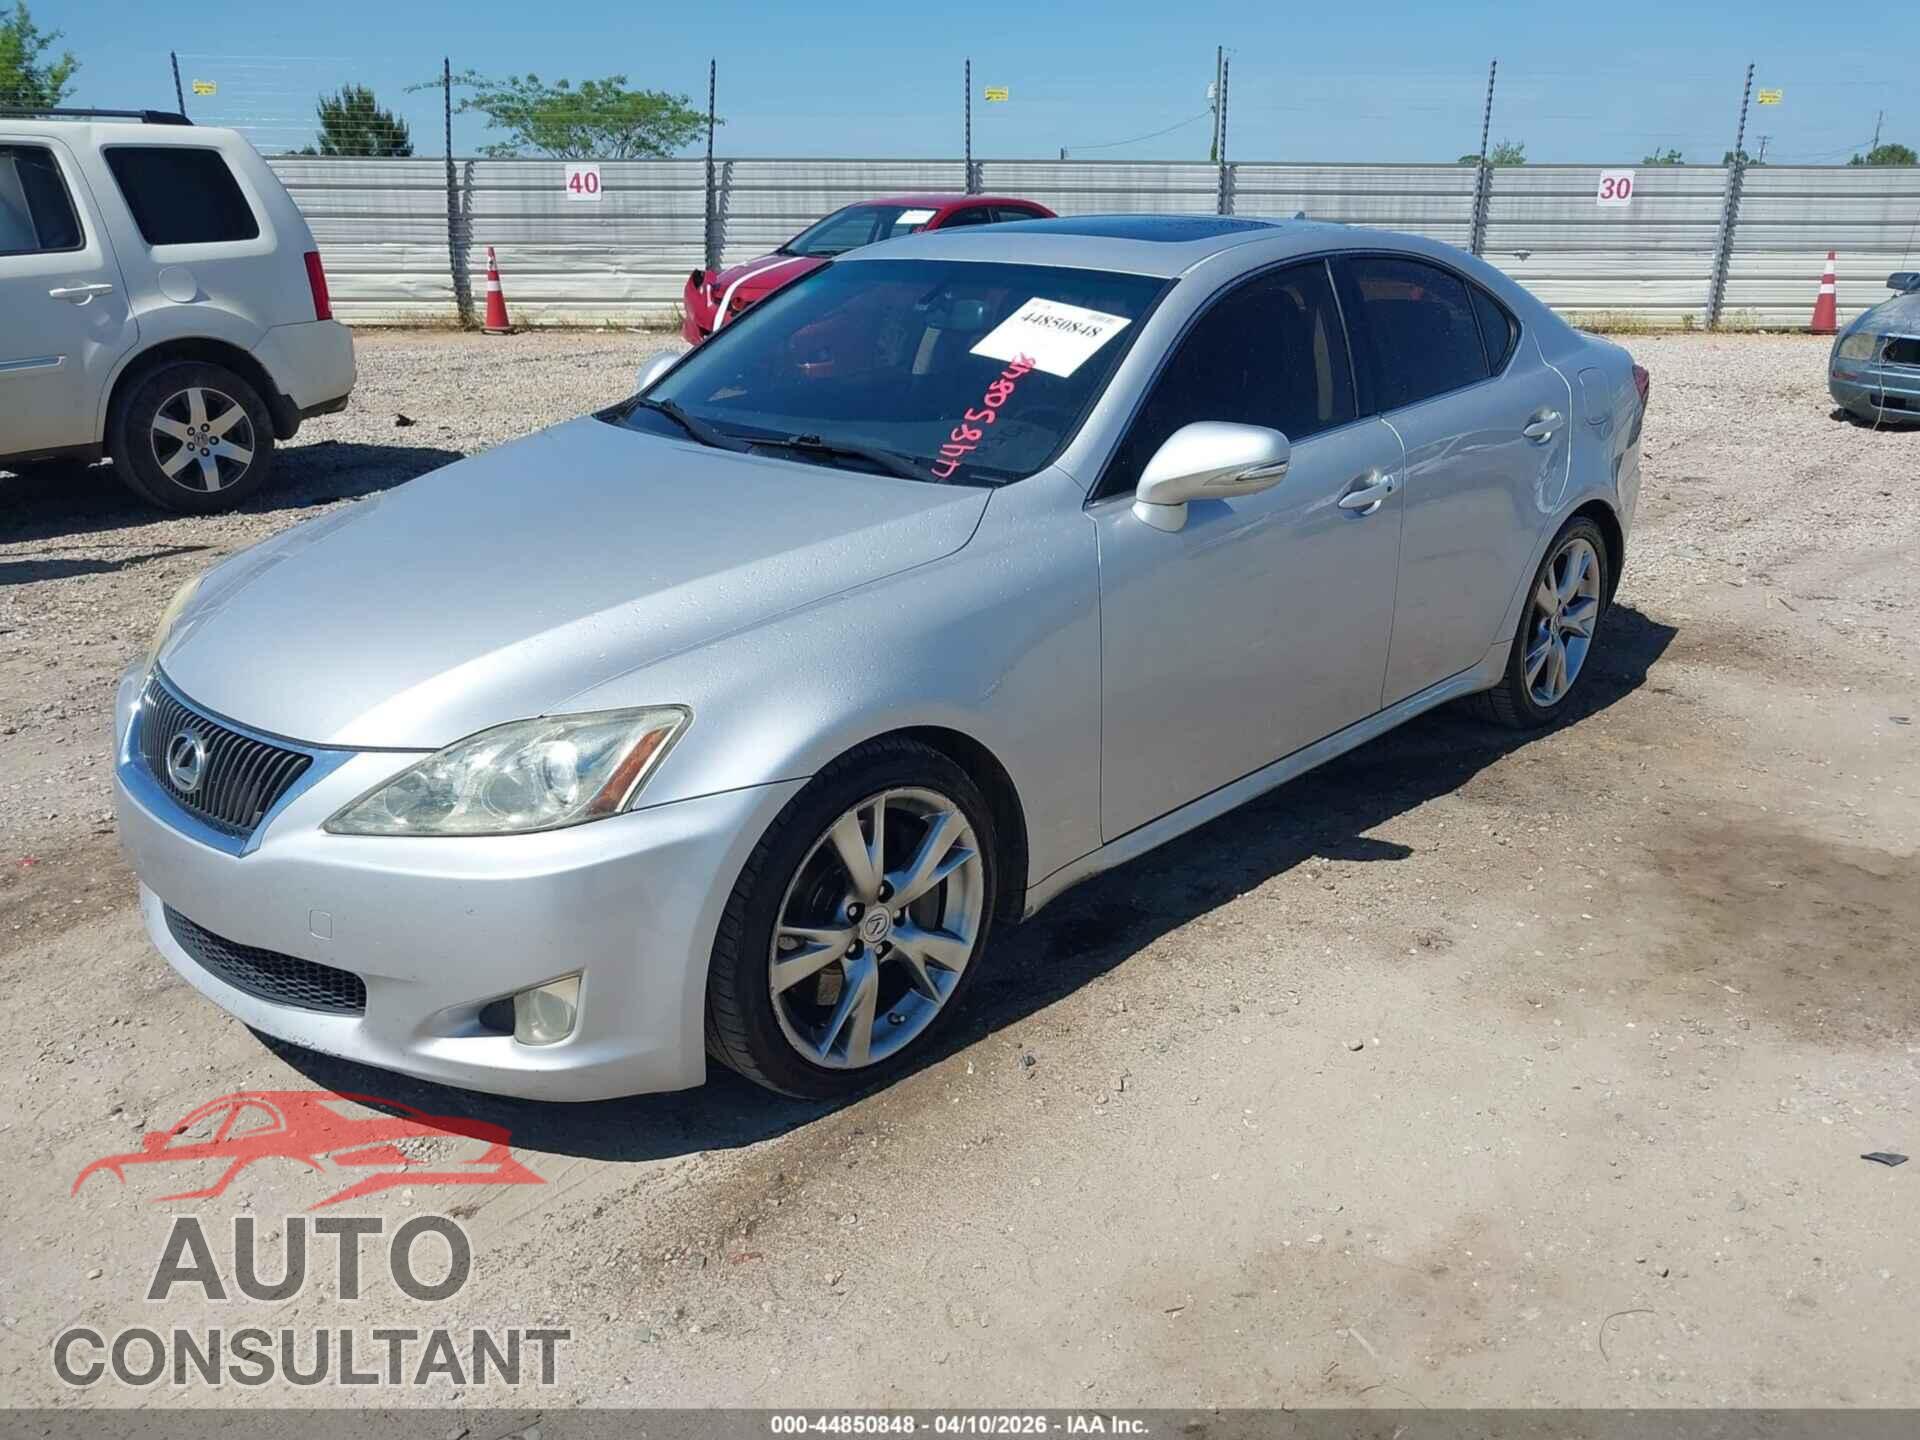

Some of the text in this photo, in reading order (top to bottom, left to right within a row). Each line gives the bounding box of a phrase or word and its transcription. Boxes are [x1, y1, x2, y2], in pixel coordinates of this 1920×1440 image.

[569, 172, 598, 193] 40
[1600, 177, 1630, 199] 30
[1022, 312, 1103, 337] 44850848
